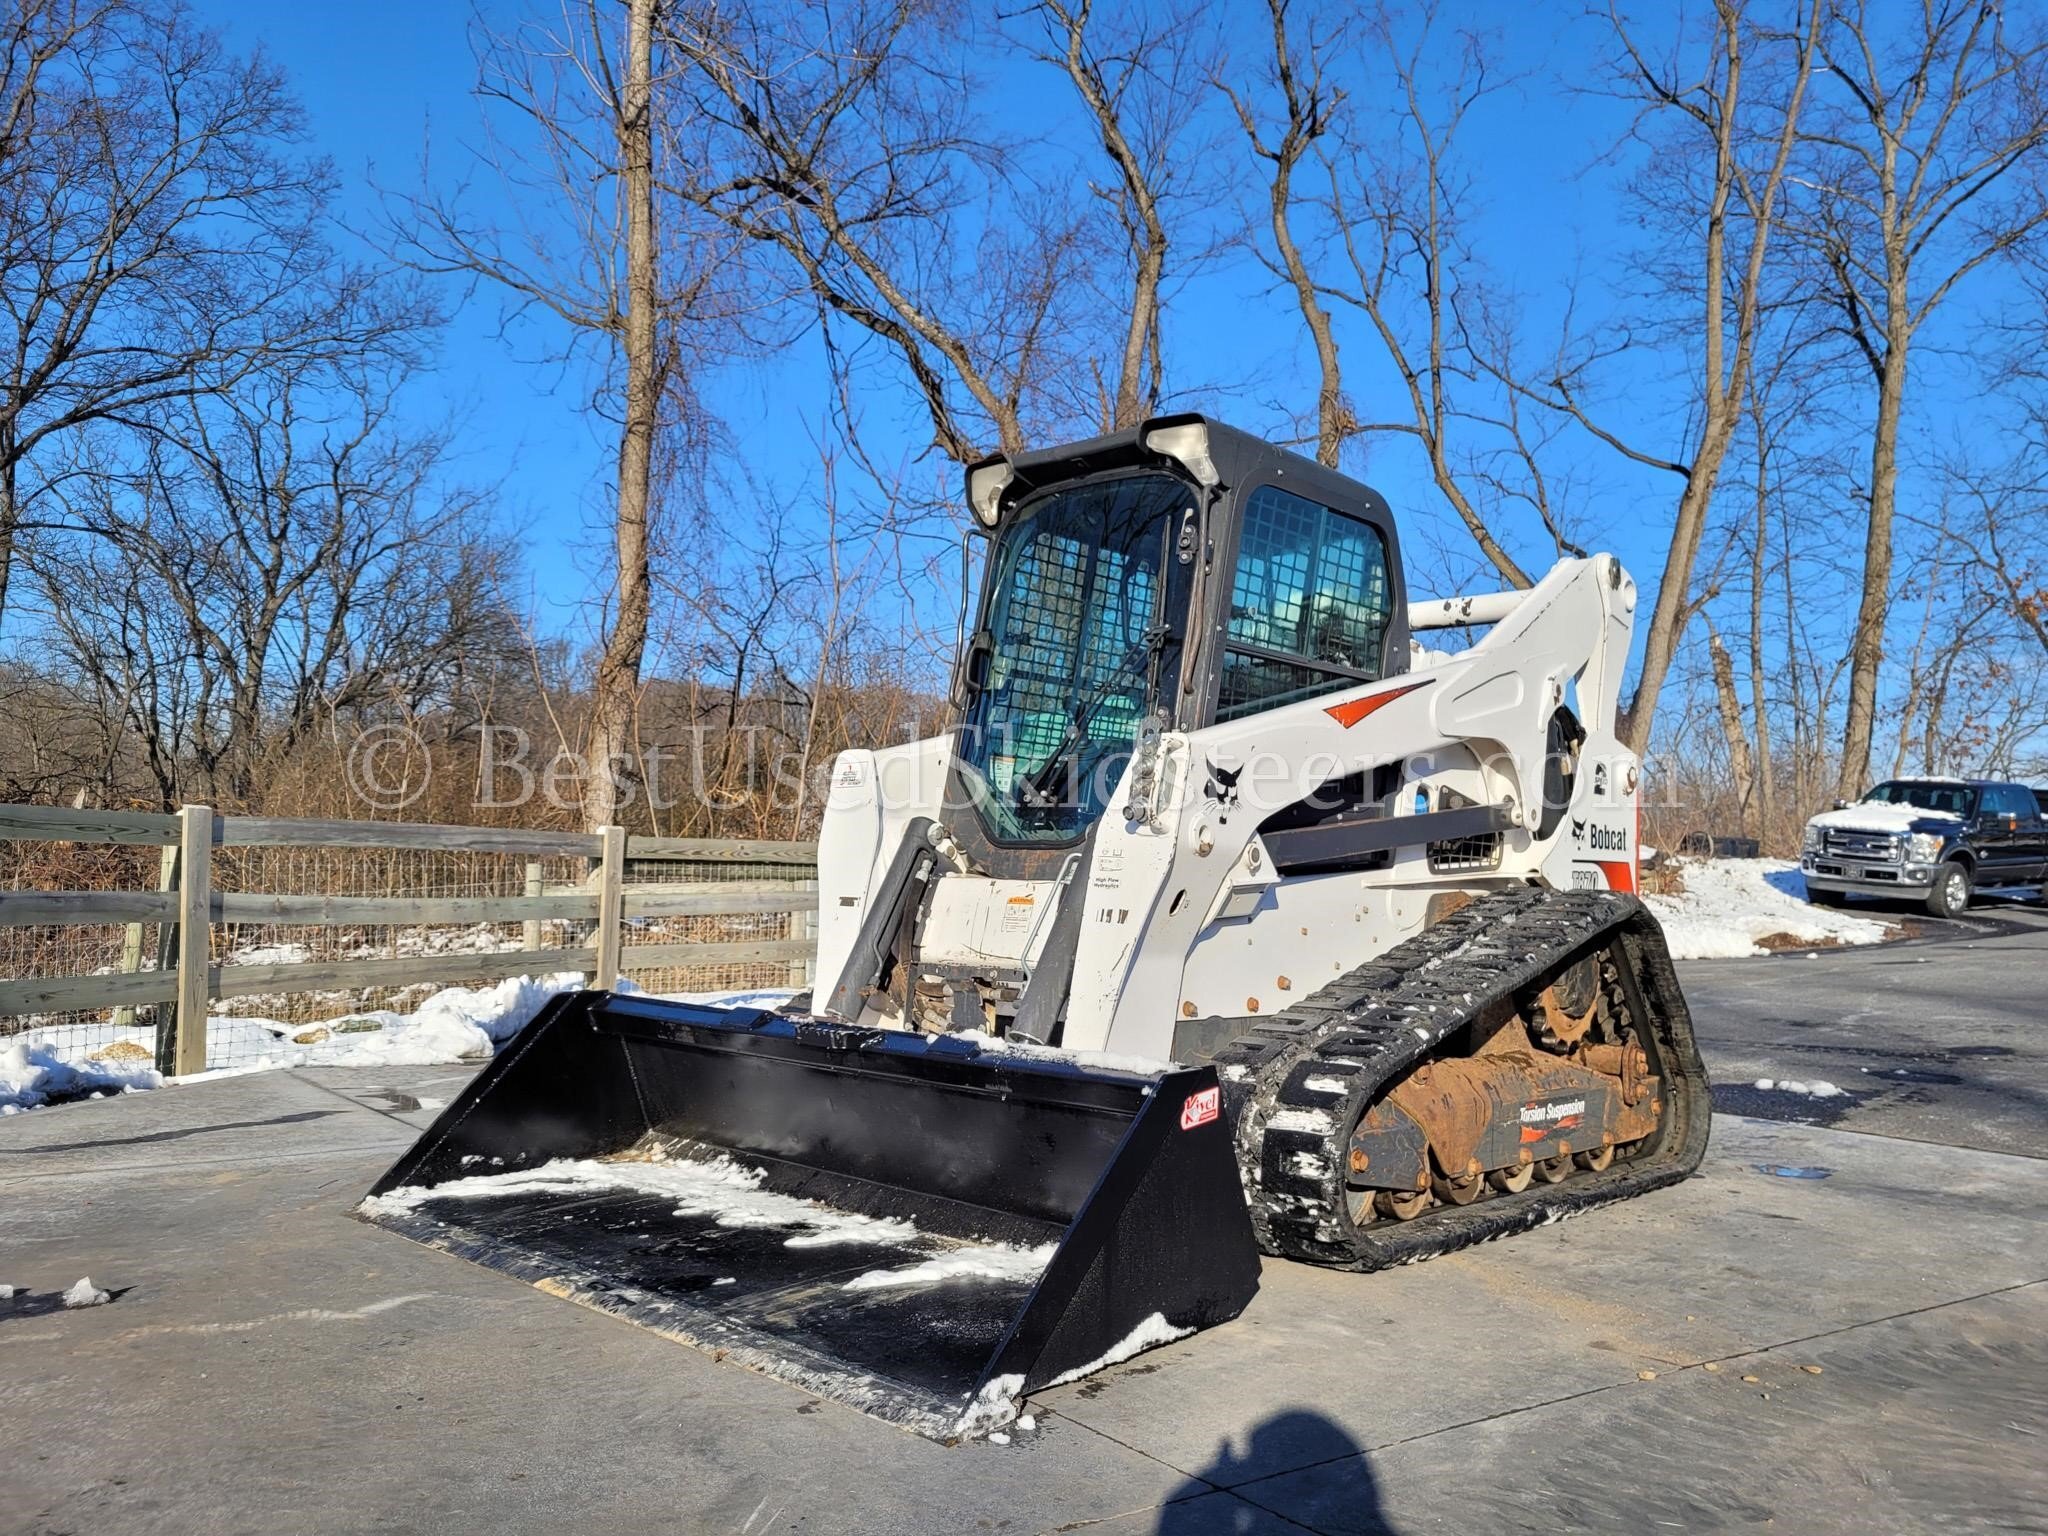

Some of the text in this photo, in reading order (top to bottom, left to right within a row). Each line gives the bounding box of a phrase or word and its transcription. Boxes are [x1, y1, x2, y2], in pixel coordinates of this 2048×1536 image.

[1590, 823, 1626, 851] Bobcat
[1520, 1099, 1585, 1122] Torsion Suspension
